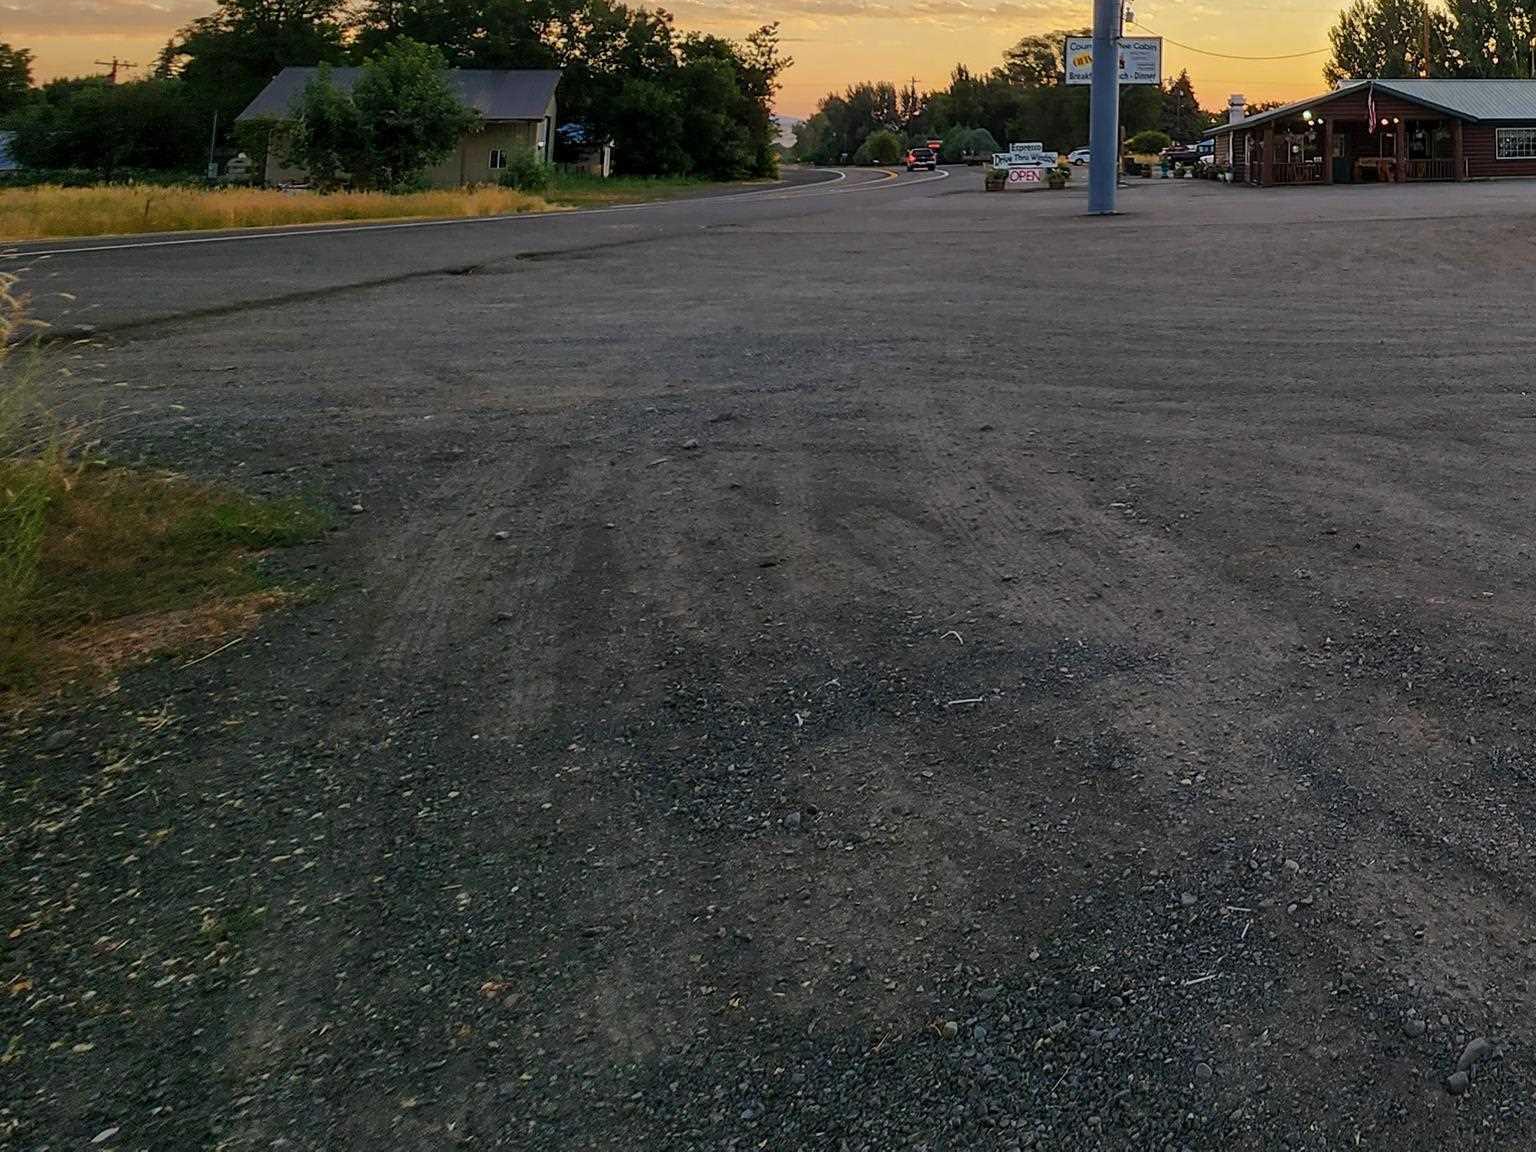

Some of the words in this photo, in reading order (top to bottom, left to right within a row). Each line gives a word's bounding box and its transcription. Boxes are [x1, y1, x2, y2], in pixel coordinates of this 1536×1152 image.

[1070, 42, 1092, 51] Coun
[1069, 72, 1092, 80] Break
[995, 154, 1012, 166] Drive
[1010, 170, 1041, 181] OPEN
